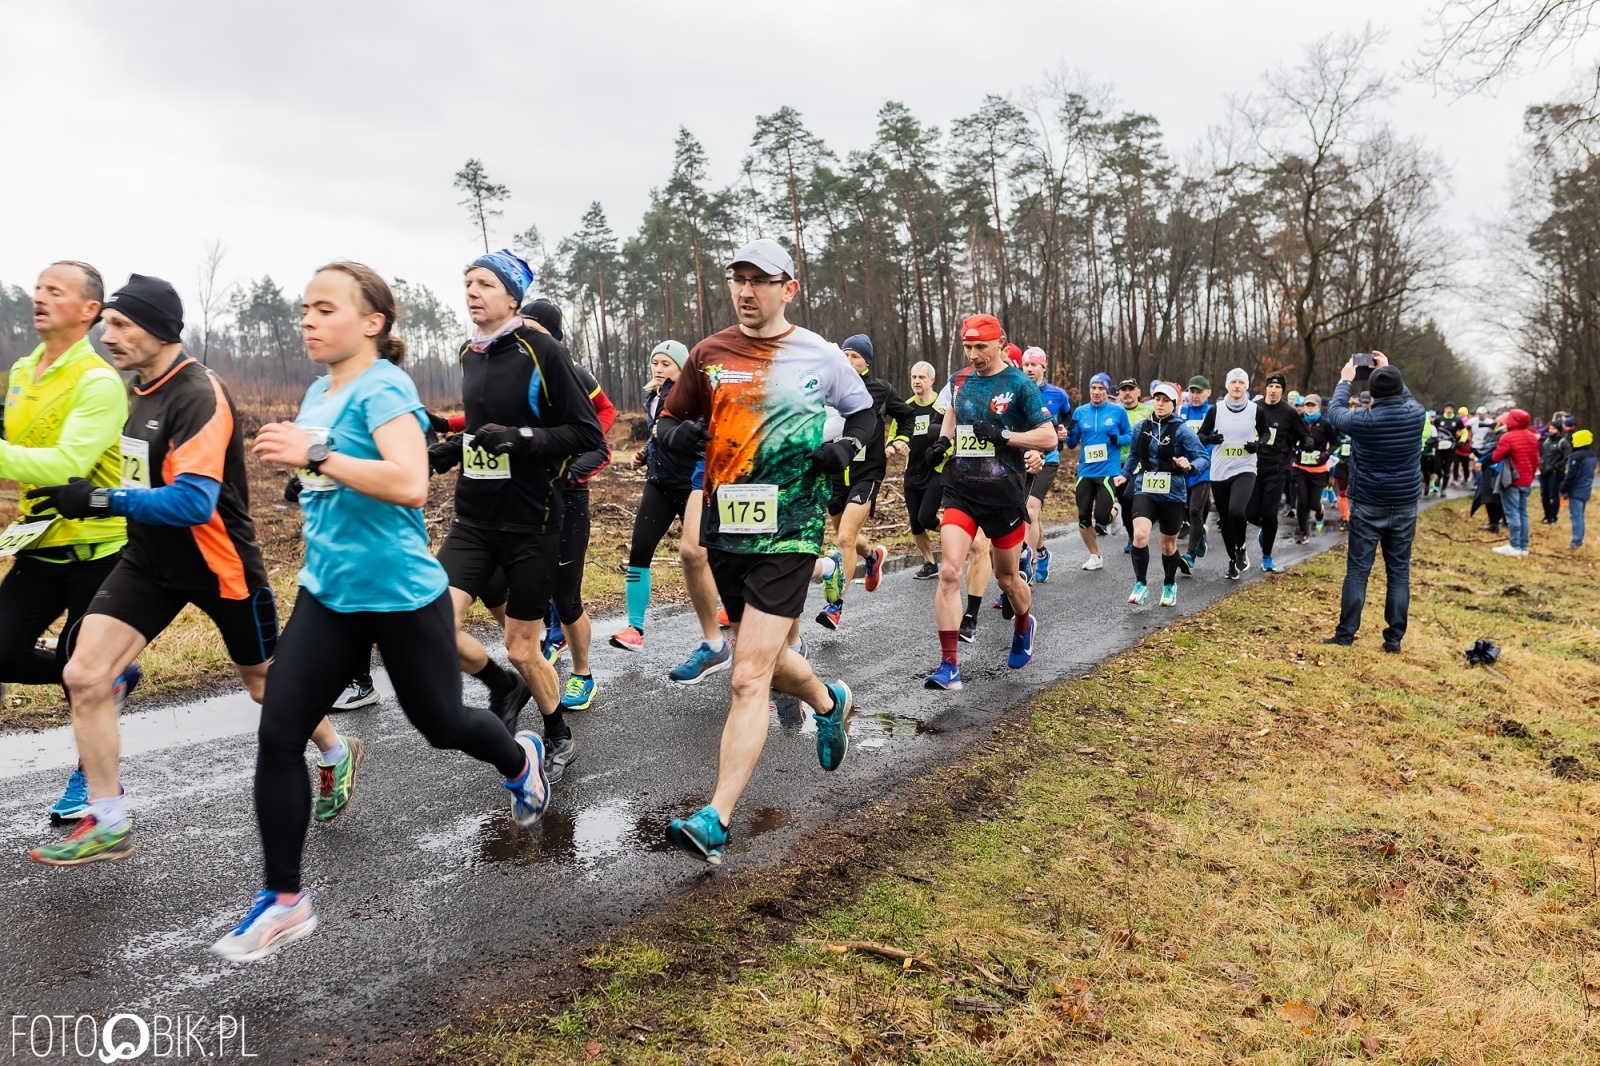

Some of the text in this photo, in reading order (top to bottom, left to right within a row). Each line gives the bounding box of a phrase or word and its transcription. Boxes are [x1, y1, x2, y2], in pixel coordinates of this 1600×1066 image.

[961, 436, 988, 450] 229
[1088, 449, 1104, 459] 158
[1225, 448, 1243, 457] 170
[466, 449, 499, 470] 248
[1146, 478, 1166, 489] 173
[727, 500, 767, 523] 175
